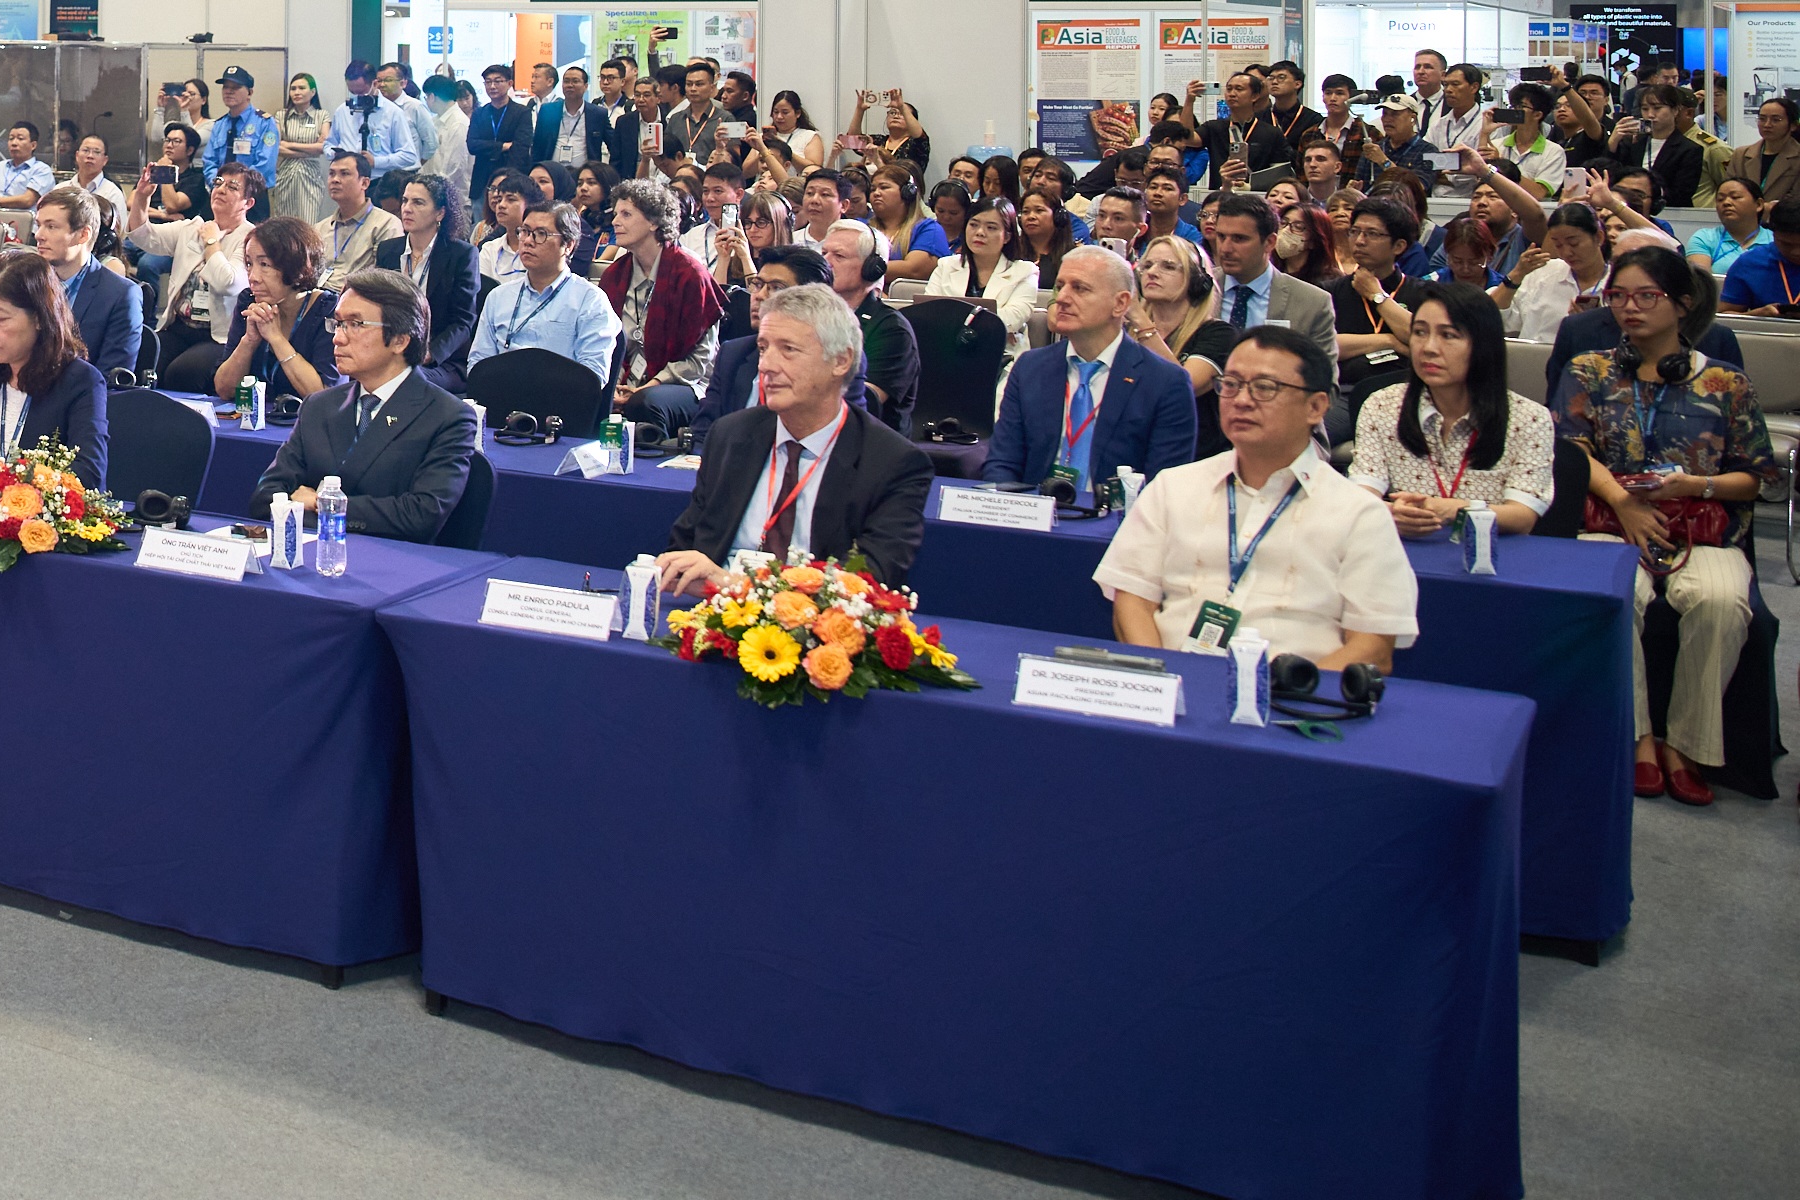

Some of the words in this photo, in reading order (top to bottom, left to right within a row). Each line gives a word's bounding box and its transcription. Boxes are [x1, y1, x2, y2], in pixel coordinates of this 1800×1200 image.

[605, 10, 647, 18] Specialize
[1231, 27, 1247, 35] FOOD
[1248, 27, 1254, 35] &
[1388, 20, 1436, 31] Piovan
[1057, 28, 1102, 44] Asia
[1105, 28, 1120, 36] FOOD
[1120, 28, 1126, 36] &
[1105, 36, 1138, 44] BEVERAGES
[1231, 35, 1266, 44] BEVERAGES
[971, 495, 1001, 504] MICHELE
[1003, 499, 1038, 508] D'ERCOLE
[161, 538, 177, 547] ÔNG
[197, 543, 211, 552] VIỆT
[212, 545, 228, 555] ANH
[507, 593, 522, 601] MR.
[524, 595, 554, 605] ENRICO
[556, 600, 590, 611] PADULA
[487, 608, 510, 616] CONSUL
[510, 611, 535, 619] GENERAL
[520, 605, 543, 613] CONSUL
[545, 608, 572, 617] GENERAL
[1051, 671, 1090, 683] JOSEPH
[1092, 677, 1118, 688] ROSS
[1121, 682, 1163, 694] JOCSON
[1074, 687, 1116, 697] PRESIDENT
[1027, 689, 1048, 697] ASIAN
[1050, 692, 1092, 703] PACKAGING
[1094, 698, 1141, 710] FEDERATION
